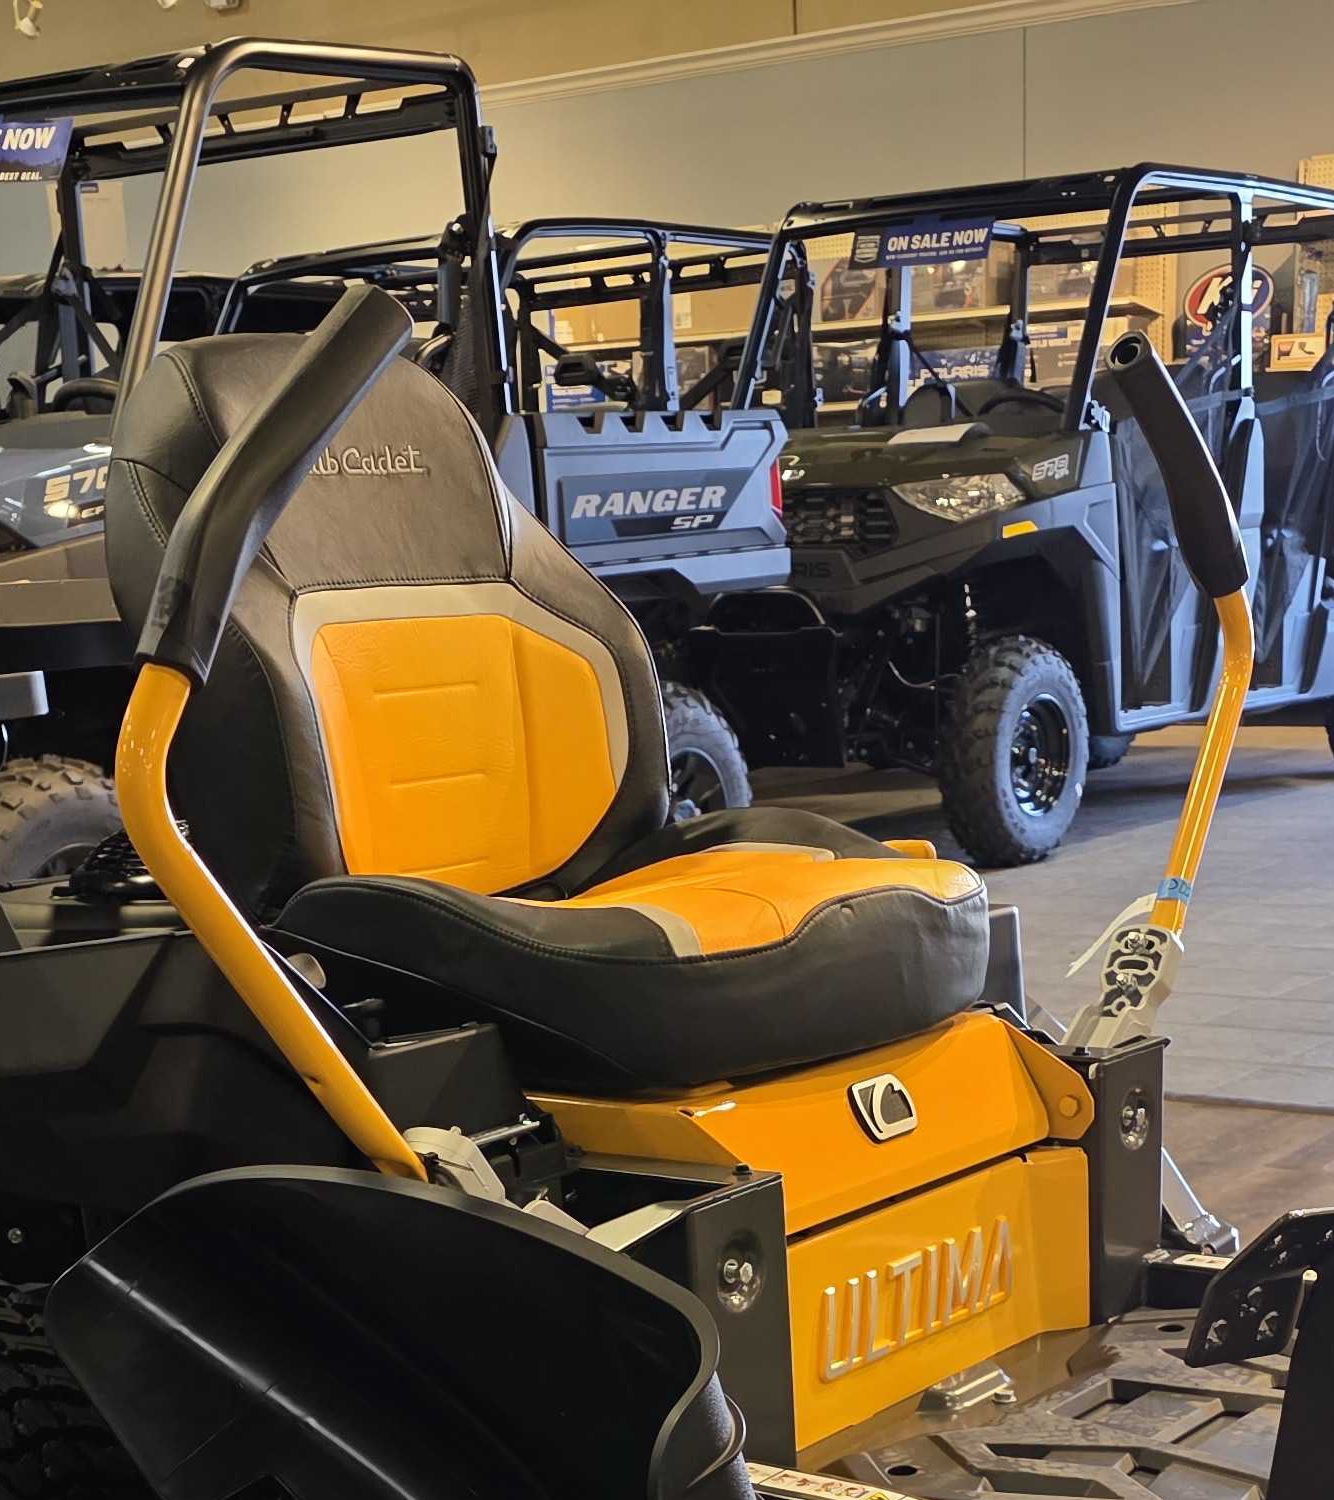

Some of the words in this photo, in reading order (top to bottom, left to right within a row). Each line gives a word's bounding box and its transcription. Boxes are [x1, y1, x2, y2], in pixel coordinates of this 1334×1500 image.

[2, 126, 56, 150] NOW
[887, 236, 909, 252] ON
[911, 231, 952, 250] SALE
[952, 227, 989, 246] NOW
[309, 447, 340, 475] ub
[342, 444, 428, 476] Cadet
[570, 485, 727, 519] RANGER
[670, 514, 715, 530] SP
[818, 1215, 1012, 1384] ULTIMA
